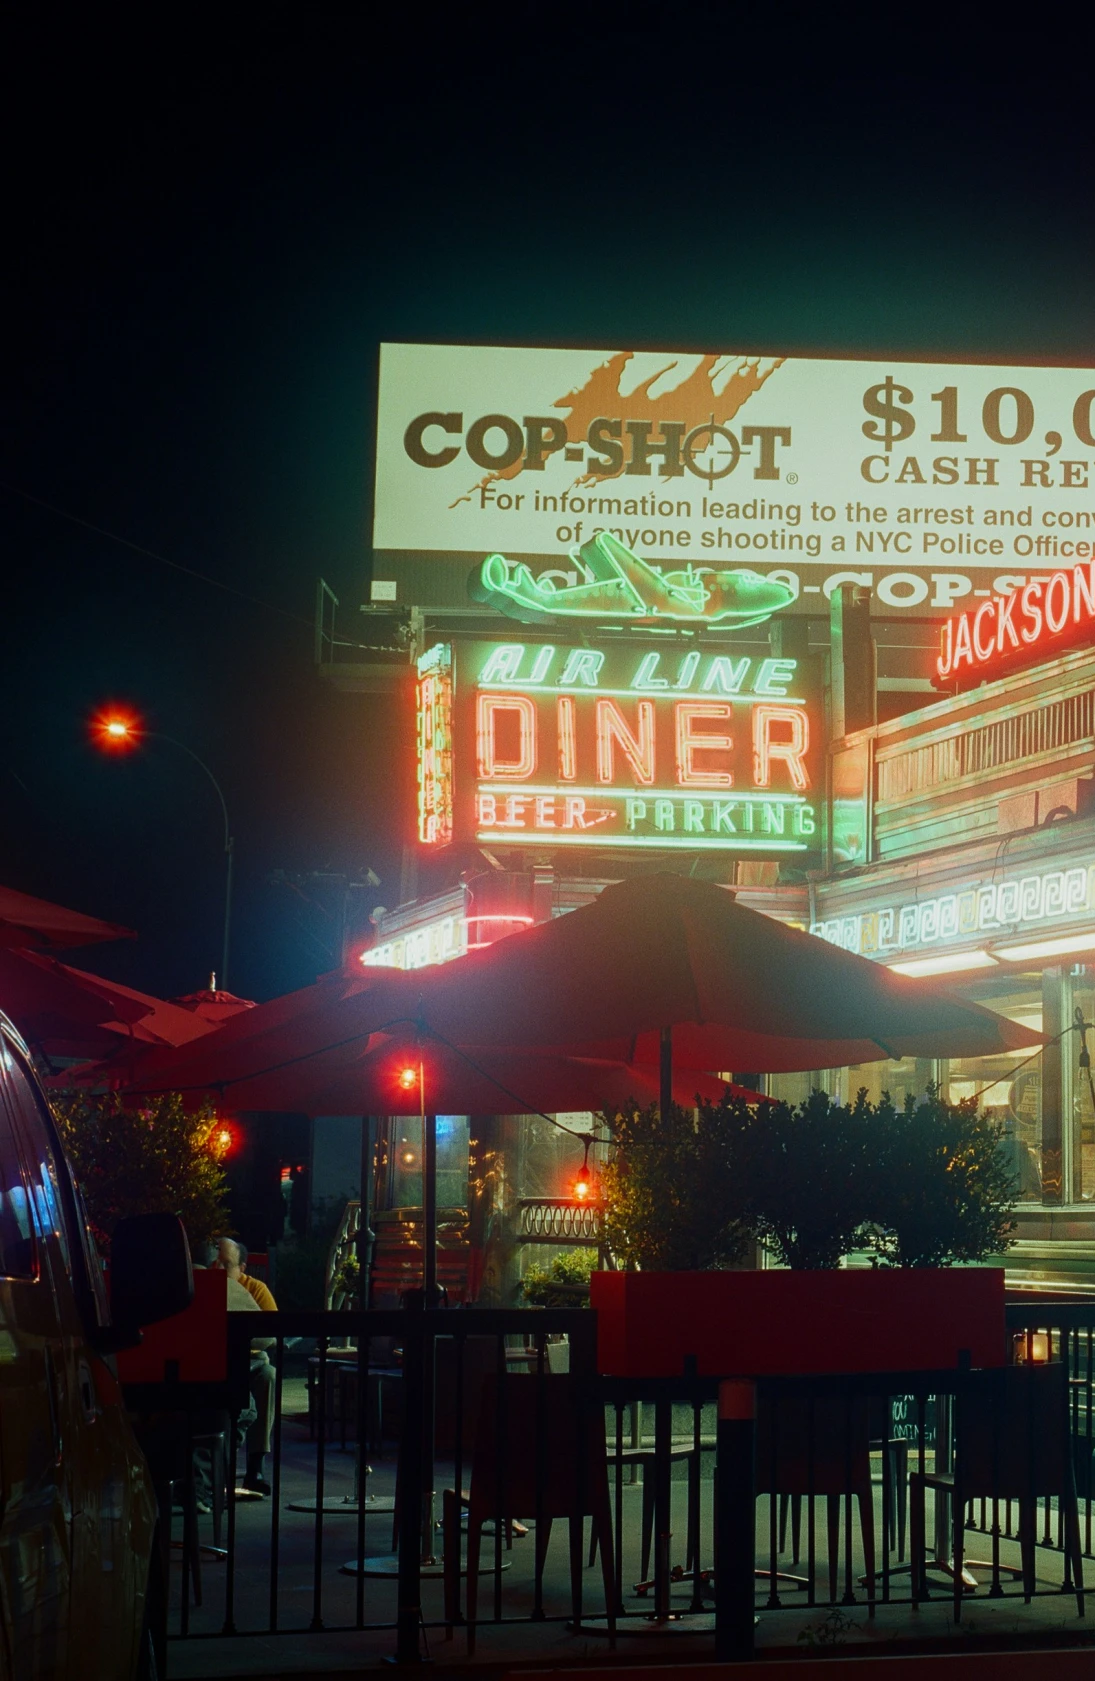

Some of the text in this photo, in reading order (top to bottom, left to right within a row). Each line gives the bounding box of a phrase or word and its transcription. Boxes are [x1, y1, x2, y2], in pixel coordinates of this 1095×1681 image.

[403, 410, 792, 488] COP-SHOT
[860, 454, 999, 487] CASH
[480, 487, 526, 511] For
[534, 490, 692, 518] information
[702, 496, 802, 527] leading
[810, 501, 837, 522] to
[845, 501, 888, 523] the
[896, 505, 975, 525] arrest
[983, 506, 1033, 527] and
[555, 521, 583, 543] of
[700, 526, 822, 557] shooting
[831, 535, 846, 552] a
[856, 531, 912, 554] NYC
[922, 531, 1004, 555] Police
[479, 643, 605, 687] AIR
[631, 651, 797, 697] LINE
[476, 693, 811, 790] DINER
[477, 795, 816, 836] BEER PARKING
